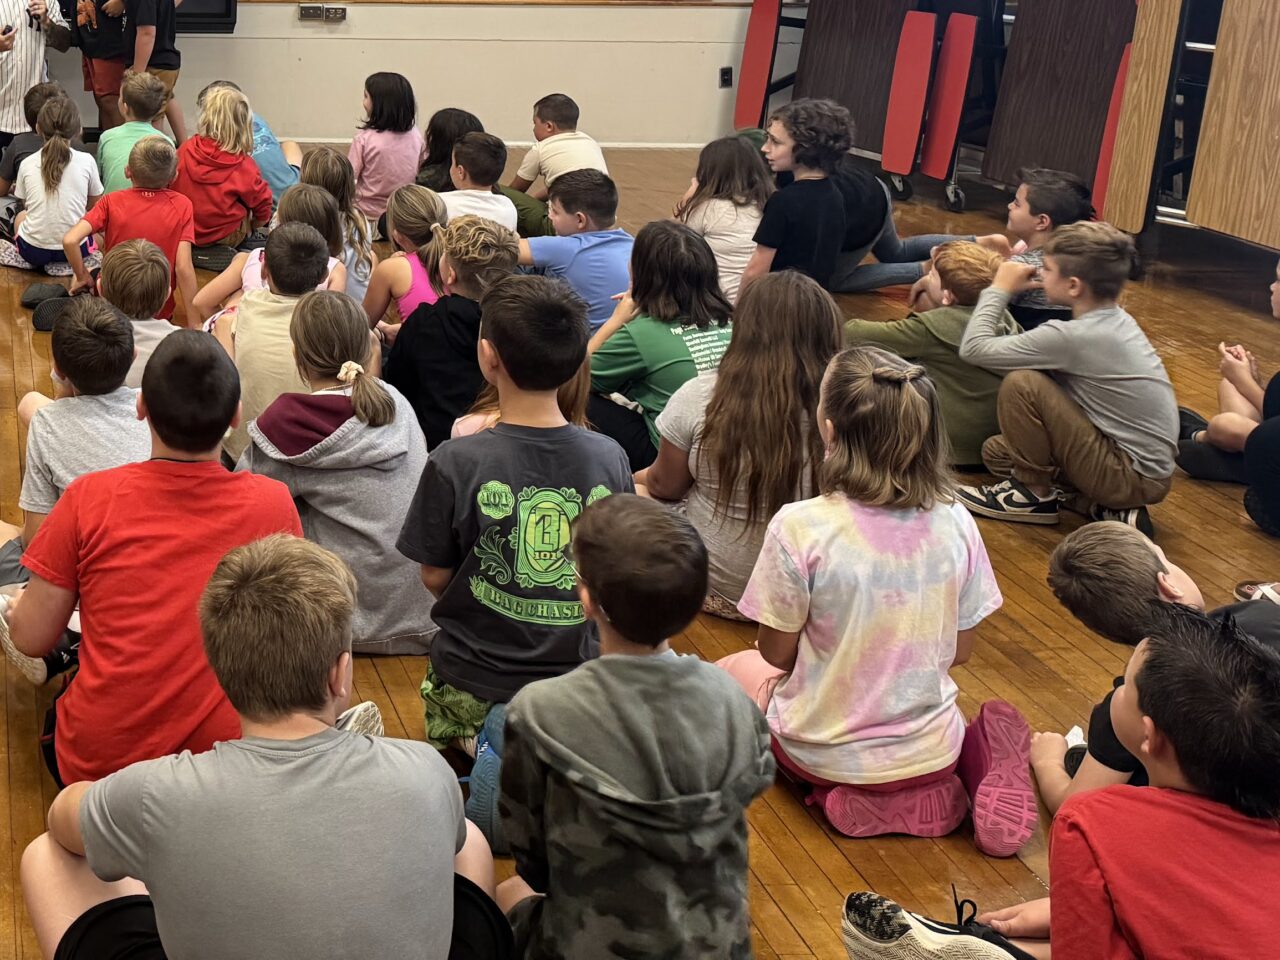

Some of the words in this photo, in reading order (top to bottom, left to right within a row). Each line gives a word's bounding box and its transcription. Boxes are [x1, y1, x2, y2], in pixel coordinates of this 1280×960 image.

[481, 491, 509, 506] 101
[534, 552, 557, 561] 101
[488, 589, 523, 616] BAG
[528, 604, 583, 620] CHASI
